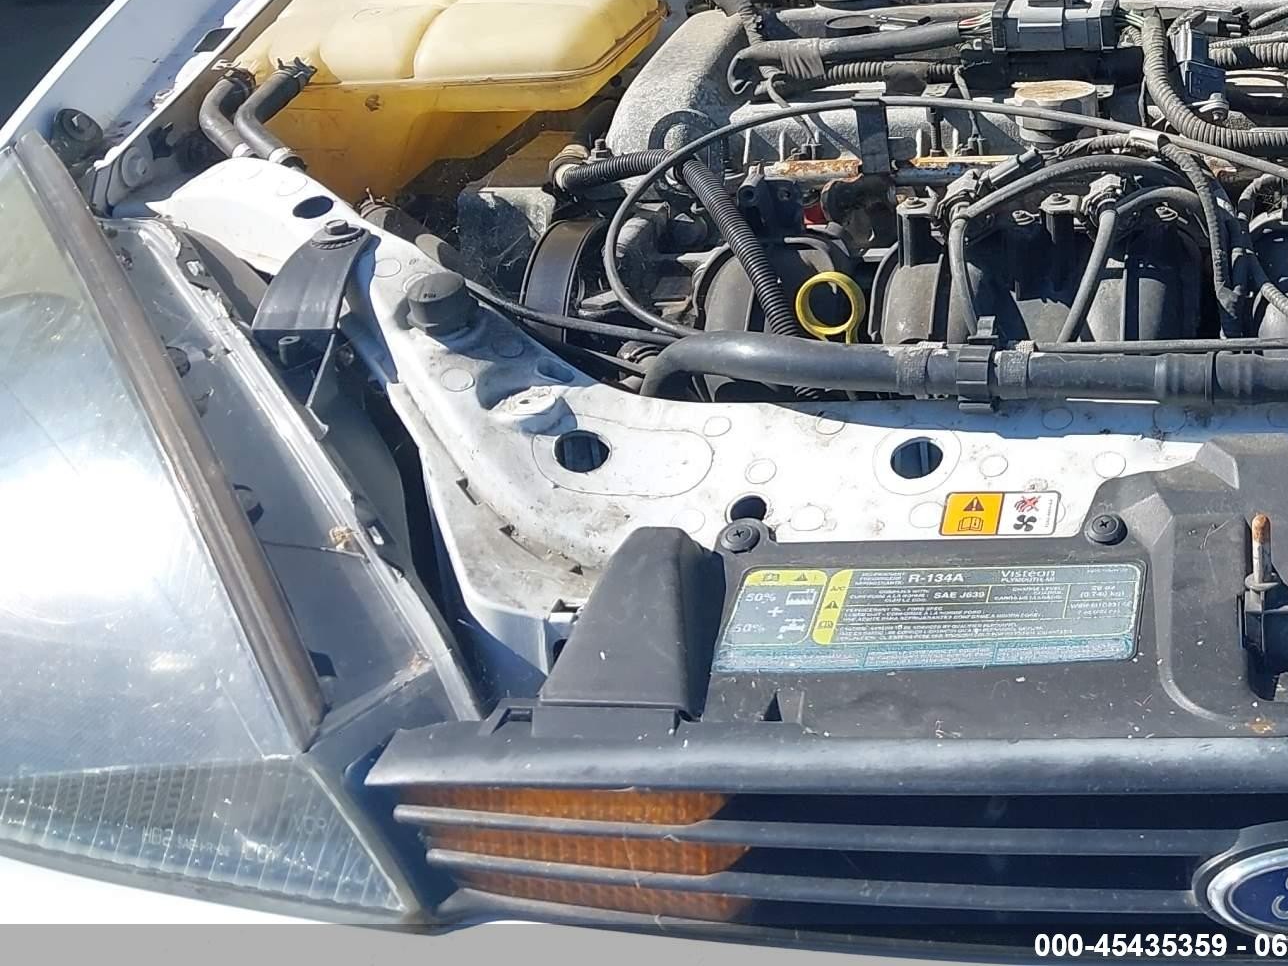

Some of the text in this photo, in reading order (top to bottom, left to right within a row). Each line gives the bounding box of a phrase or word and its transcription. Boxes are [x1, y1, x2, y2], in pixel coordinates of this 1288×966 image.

[908, 573, 964, 584] R-134A
[1001, 570, 1056, 579] Visteon
[745, 593, 777, 604] 50%
[933, 591, 957, 600] SAE
[959, 591, 985, 599] J639
[734, 623, 765, 634] 50%
